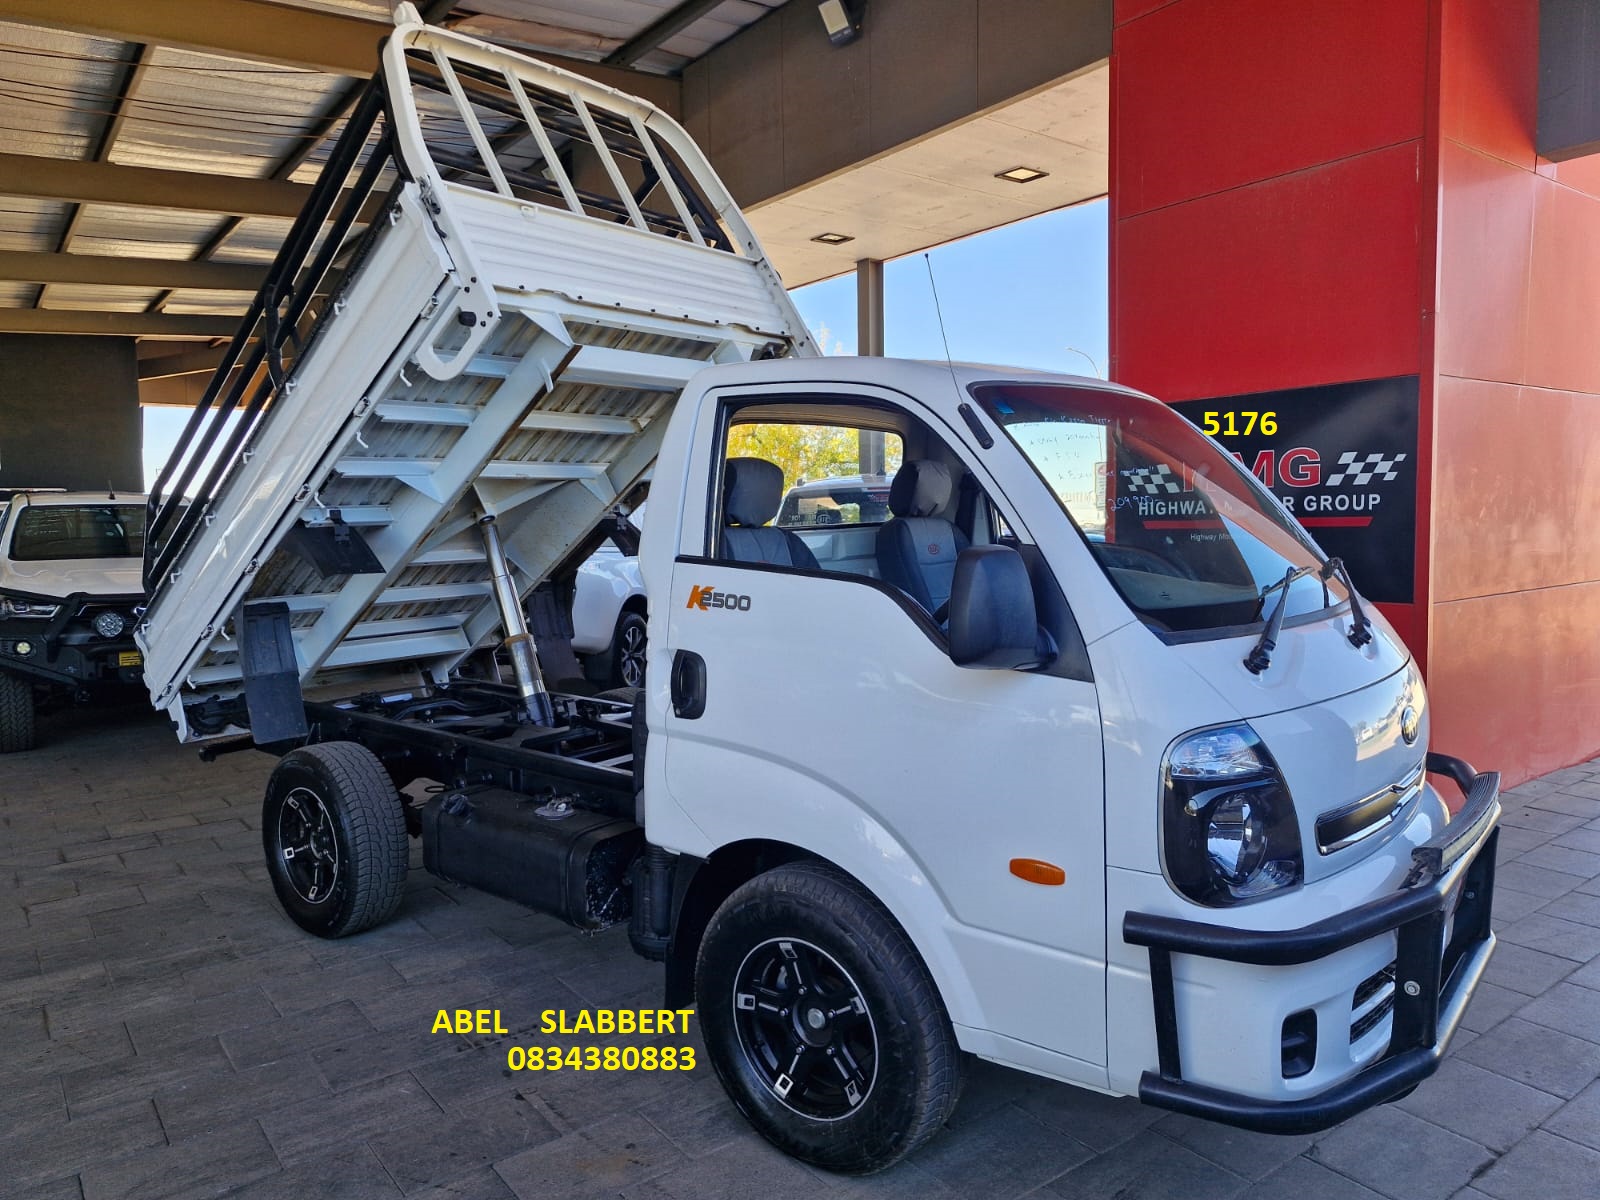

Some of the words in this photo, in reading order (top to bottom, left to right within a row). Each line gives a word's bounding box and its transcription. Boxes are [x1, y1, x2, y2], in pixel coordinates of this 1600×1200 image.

[1138, 499, 1215, 516] HIGHWA
[1303, 494, 1382, 512] GROUP
[1190, 533, 1217, 543] Highway
[686, 585, 751, 611] K2500
